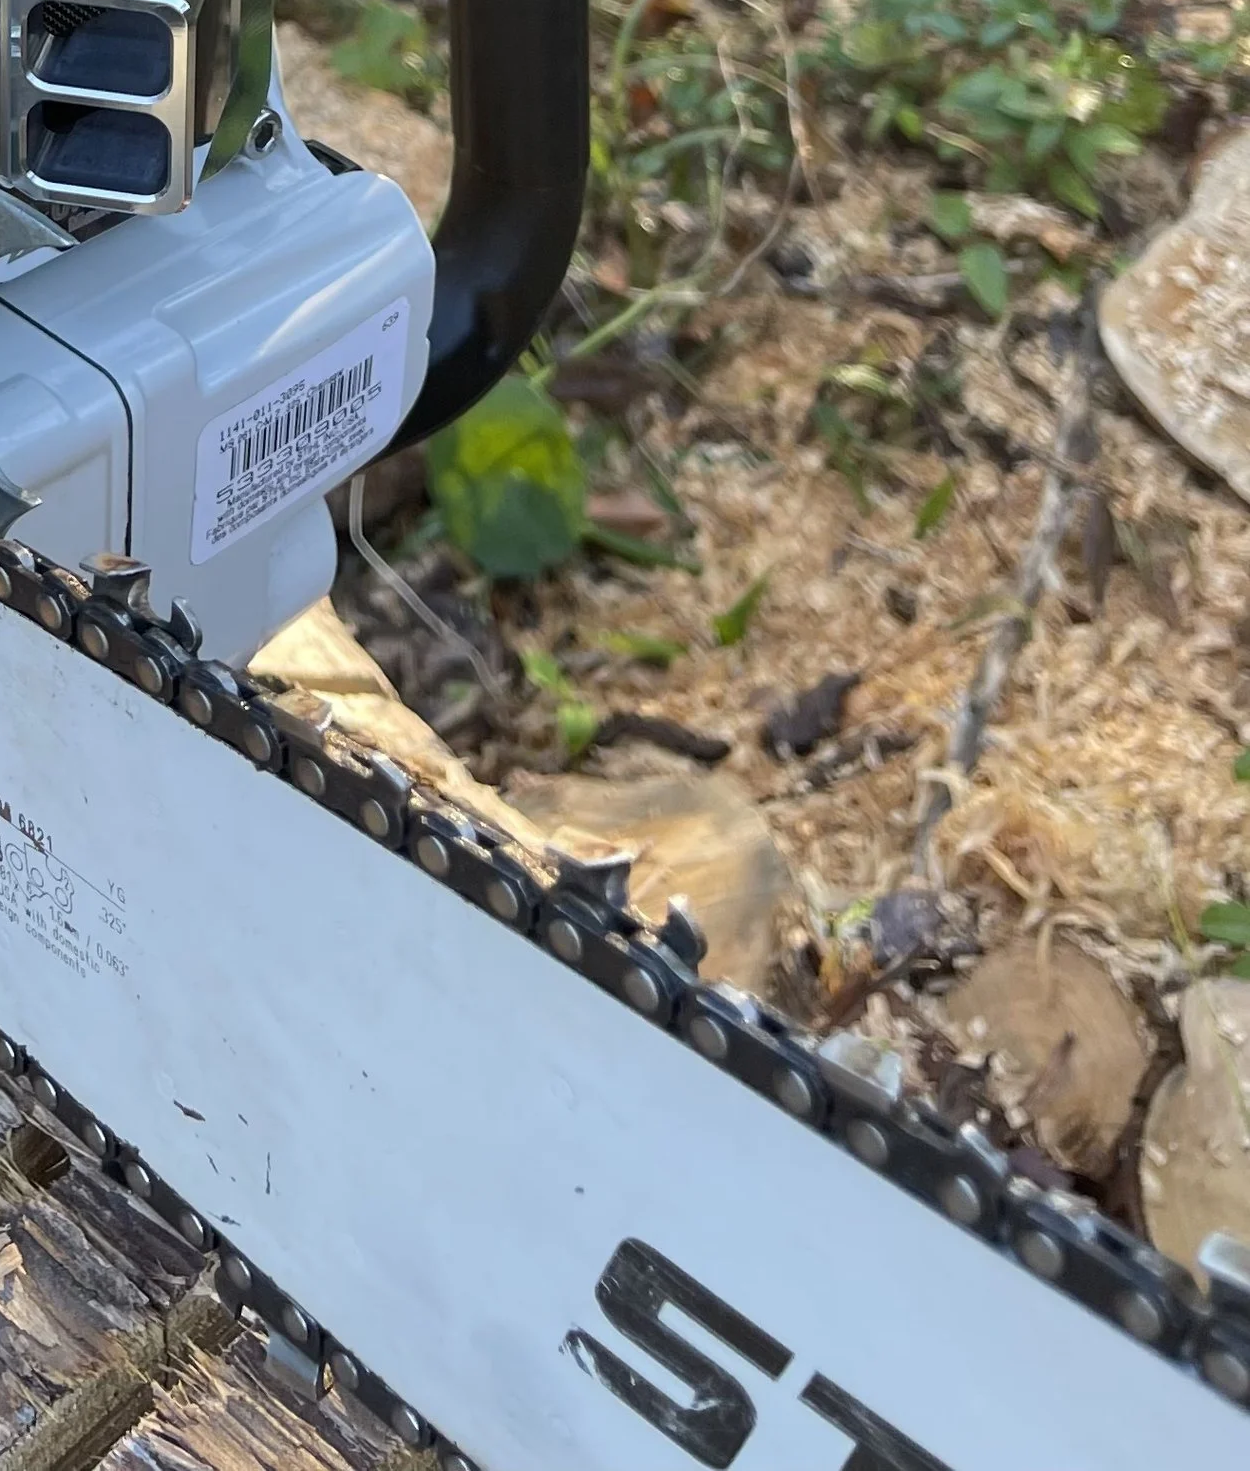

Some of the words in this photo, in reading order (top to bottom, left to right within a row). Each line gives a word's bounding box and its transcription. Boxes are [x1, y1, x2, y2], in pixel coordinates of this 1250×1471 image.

[216, 379, 382, 505] 533309005
[219, 377, 306, 443] 1141-011-3095
[107, 877, 125, 905] YG
[25, 907, 47, 931] with
[52, 924, 100, 974] domestic
[25, 921, 86, 978] components
